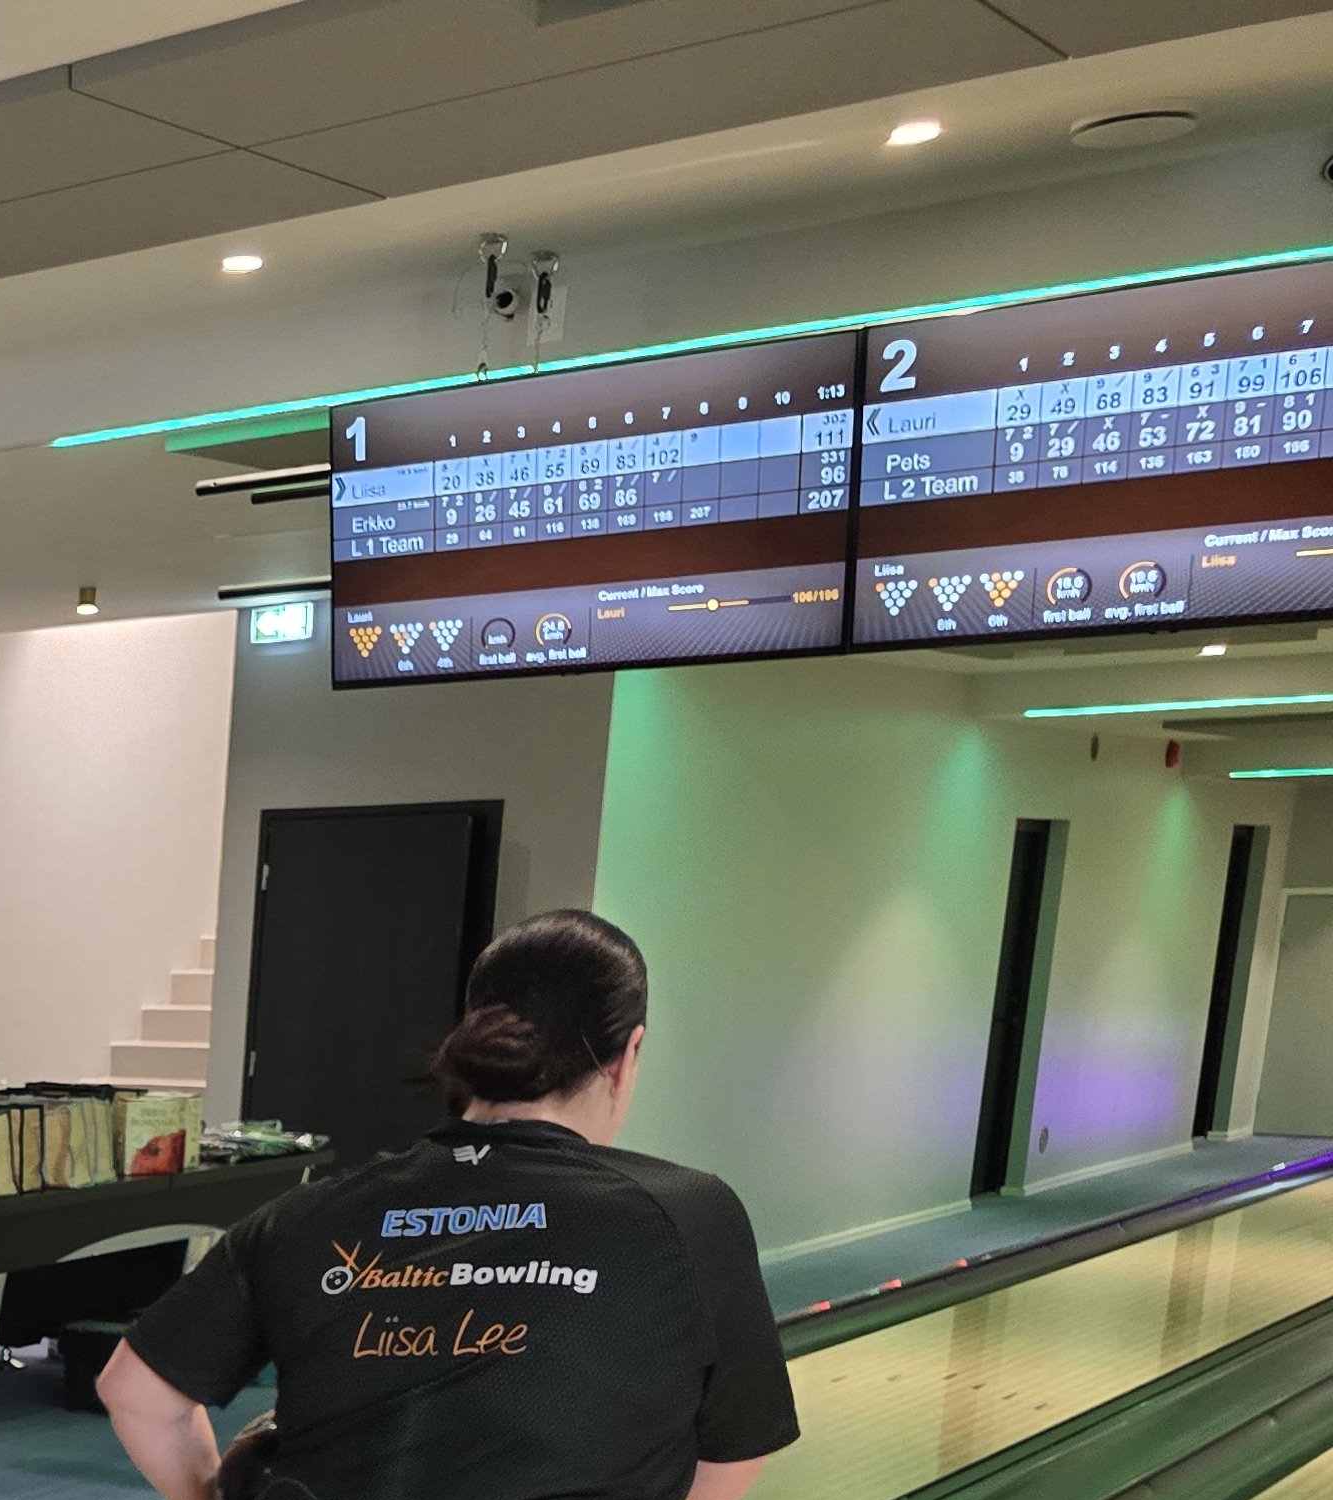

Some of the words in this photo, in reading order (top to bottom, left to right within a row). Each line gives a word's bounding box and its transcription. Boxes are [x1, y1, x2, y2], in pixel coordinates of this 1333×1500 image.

[880, 339, 917, 393] 2
[1019, 357, 1028, 371] 1
[1063, 351, 1075, 366] 2
[1109, 345, 1120, 359] 3
[1155, 338, 1167, 352] 4
[1203, 332, 1215, 346] 5
[1251, 326, 1263, 340] 6
[1301, 319, 1314, 334] 7
[449, 435, 456, 447] 1
[482, 430, 491, 443] 2
[517, 426, 525, 438] 3
[551, 421, 561, 434] 4
[661, 406, 671, 420] 7
[775, 391, 791, 405] 10
[888, 412, 937, 434] Lauri
[1007, 404, 1031, 422] 29
[1050, 398, 1076, 415] 49
[1096, 392, 1121, 410] 68
[1142, 386, 1169, 405] 83
[1189, 380, 1215, 398] 91
[1237, 375, 1265, 393] 99
[1280, 368, 1321, 388] 106
[345, 416, 366, 462] 1
[442, 475, 460, 490] 20
[475, 471, 494, 486] 38
[509, 466, 529, 481] 46
[545, 462, 565, 478] 55
[580, 458, 600, 473] 69
[616, 453, 636, 470] 83
[647, 449, 679, 465] 102
[815, 431, 844, 446] 111
[886, 453, 931, 474] Pets
[1009, 442, 1024, 462] 9
[1047, 437, 1075, 457] 29
[1092, 431, 1121, 452] 46
[1139, 426, 1167, 447] 53
[1186, 420, 1216, 441] 72
[1233, 414, 1262, 436] 81
[1282, 409, 1313, 431] 90
[351, 515, 396, 534] Erkko
[446, 508, 457, 525] 9
[474, 505, 497, 521] 26
[508, 501, 531, 518] 45
[543, 497, 564, 514] 61
[579, 493, 601, 510] 69
[614, 489, 637, 506] 86
[820, 465, 845, 484] 96
[884, 481, 897, 500] L
[901, 478, 915, 499] 2
[921, 474, 979, 495] Team
[1094, 460, 1118, 475] 114
[351, 540, 361, 557] L
[366, 539, 374, 555] 1
[380, 534, 424, 554] Team
[807, 489, 844, 510] 207
[1204, 532, 1259, 547] Current
[1268, 528, 1299, 541] Max
[381, 1203, 547, 1237] ESTONIA
[353, 1312, 438, 1358] Liisa
[453, 1309, 528, 1356] Lee
